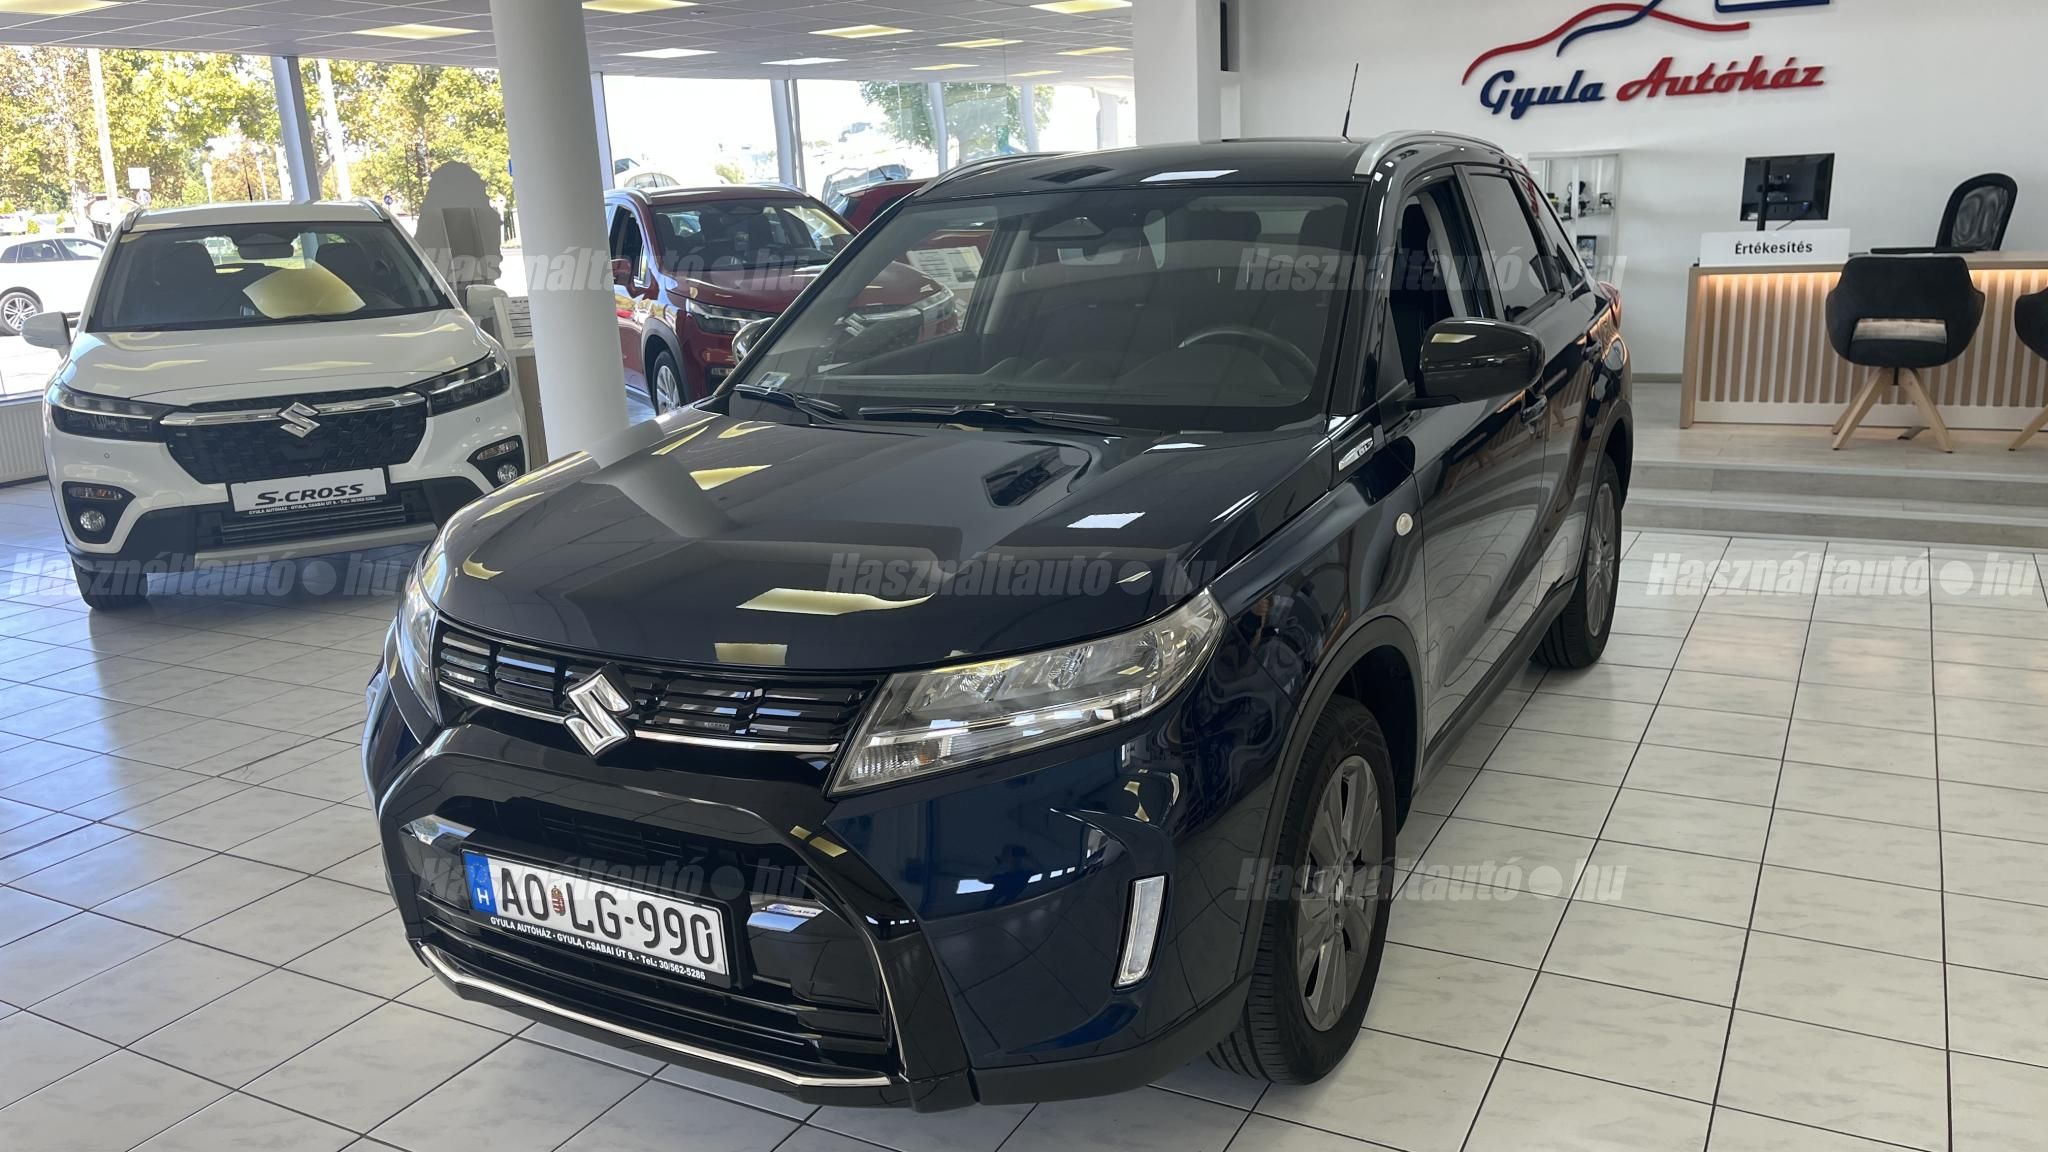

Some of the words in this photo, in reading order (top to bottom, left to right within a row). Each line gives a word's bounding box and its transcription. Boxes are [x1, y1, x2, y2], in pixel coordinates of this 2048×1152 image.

[1480, 69, 1606, 120] Gyula
[1616, 55, 1825, 101] Autóház
[1735, 240, 1813, 255] Értékesítés
[255, 483, 364, 506] S-CROSS
[477, 887, 490, 906] H
[501, 867, 550, 921] AO
[566, 882, 715, 964] LG-990
[490, 916, 516, 930] GYULA
[517, 922, 552, 939] AUTÓHÁZ
[557, 933, 585, 949] GYULA,
[586, 940, 615, 956] CSABAI
[615, 947, 627, 958] ÚT
[628, 951, 635, 961] 9.
[659, 960, 706, 981] 30/562-5286
